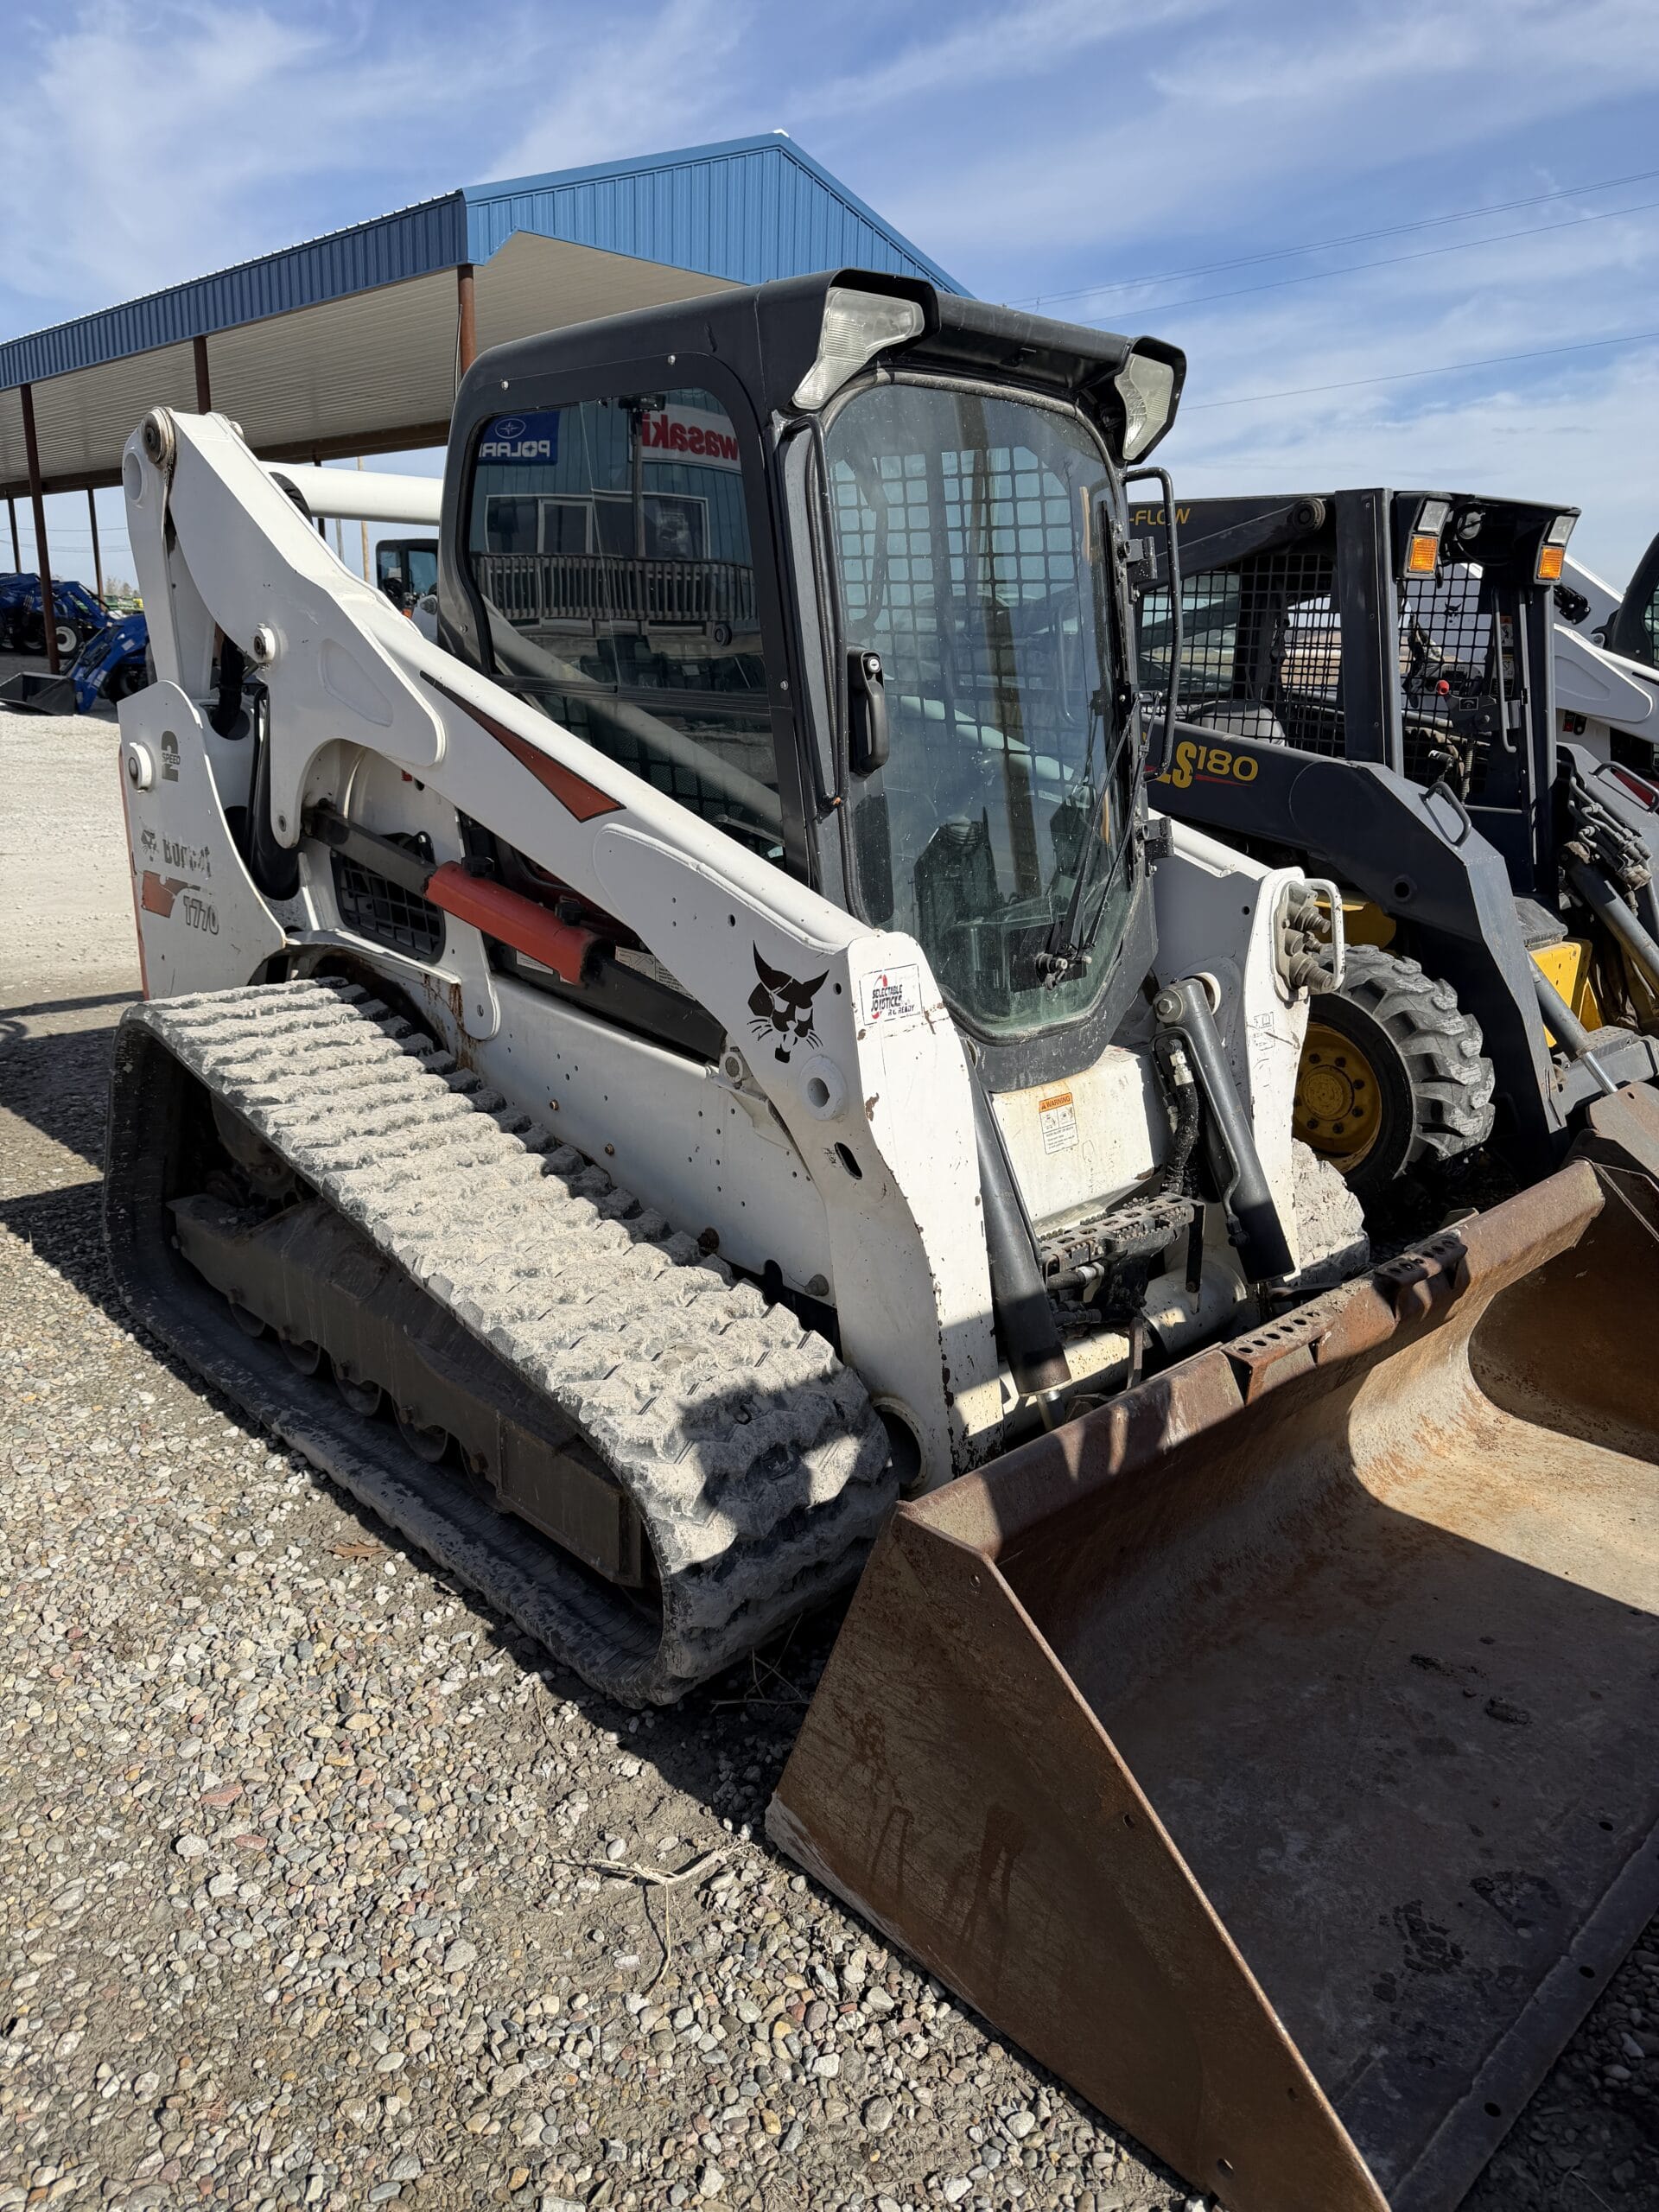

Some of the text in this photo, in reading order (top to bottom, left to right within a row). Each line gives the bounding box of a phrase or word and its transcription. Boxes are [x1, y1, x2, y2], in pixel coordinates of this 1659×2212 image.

[162, 752, 181, 766] SPEED
[183, 895, 219, 935] T770
[872, 984, 903, 999] SELECTABLE
[1046, 1095, 1071, 1108] WARNING
